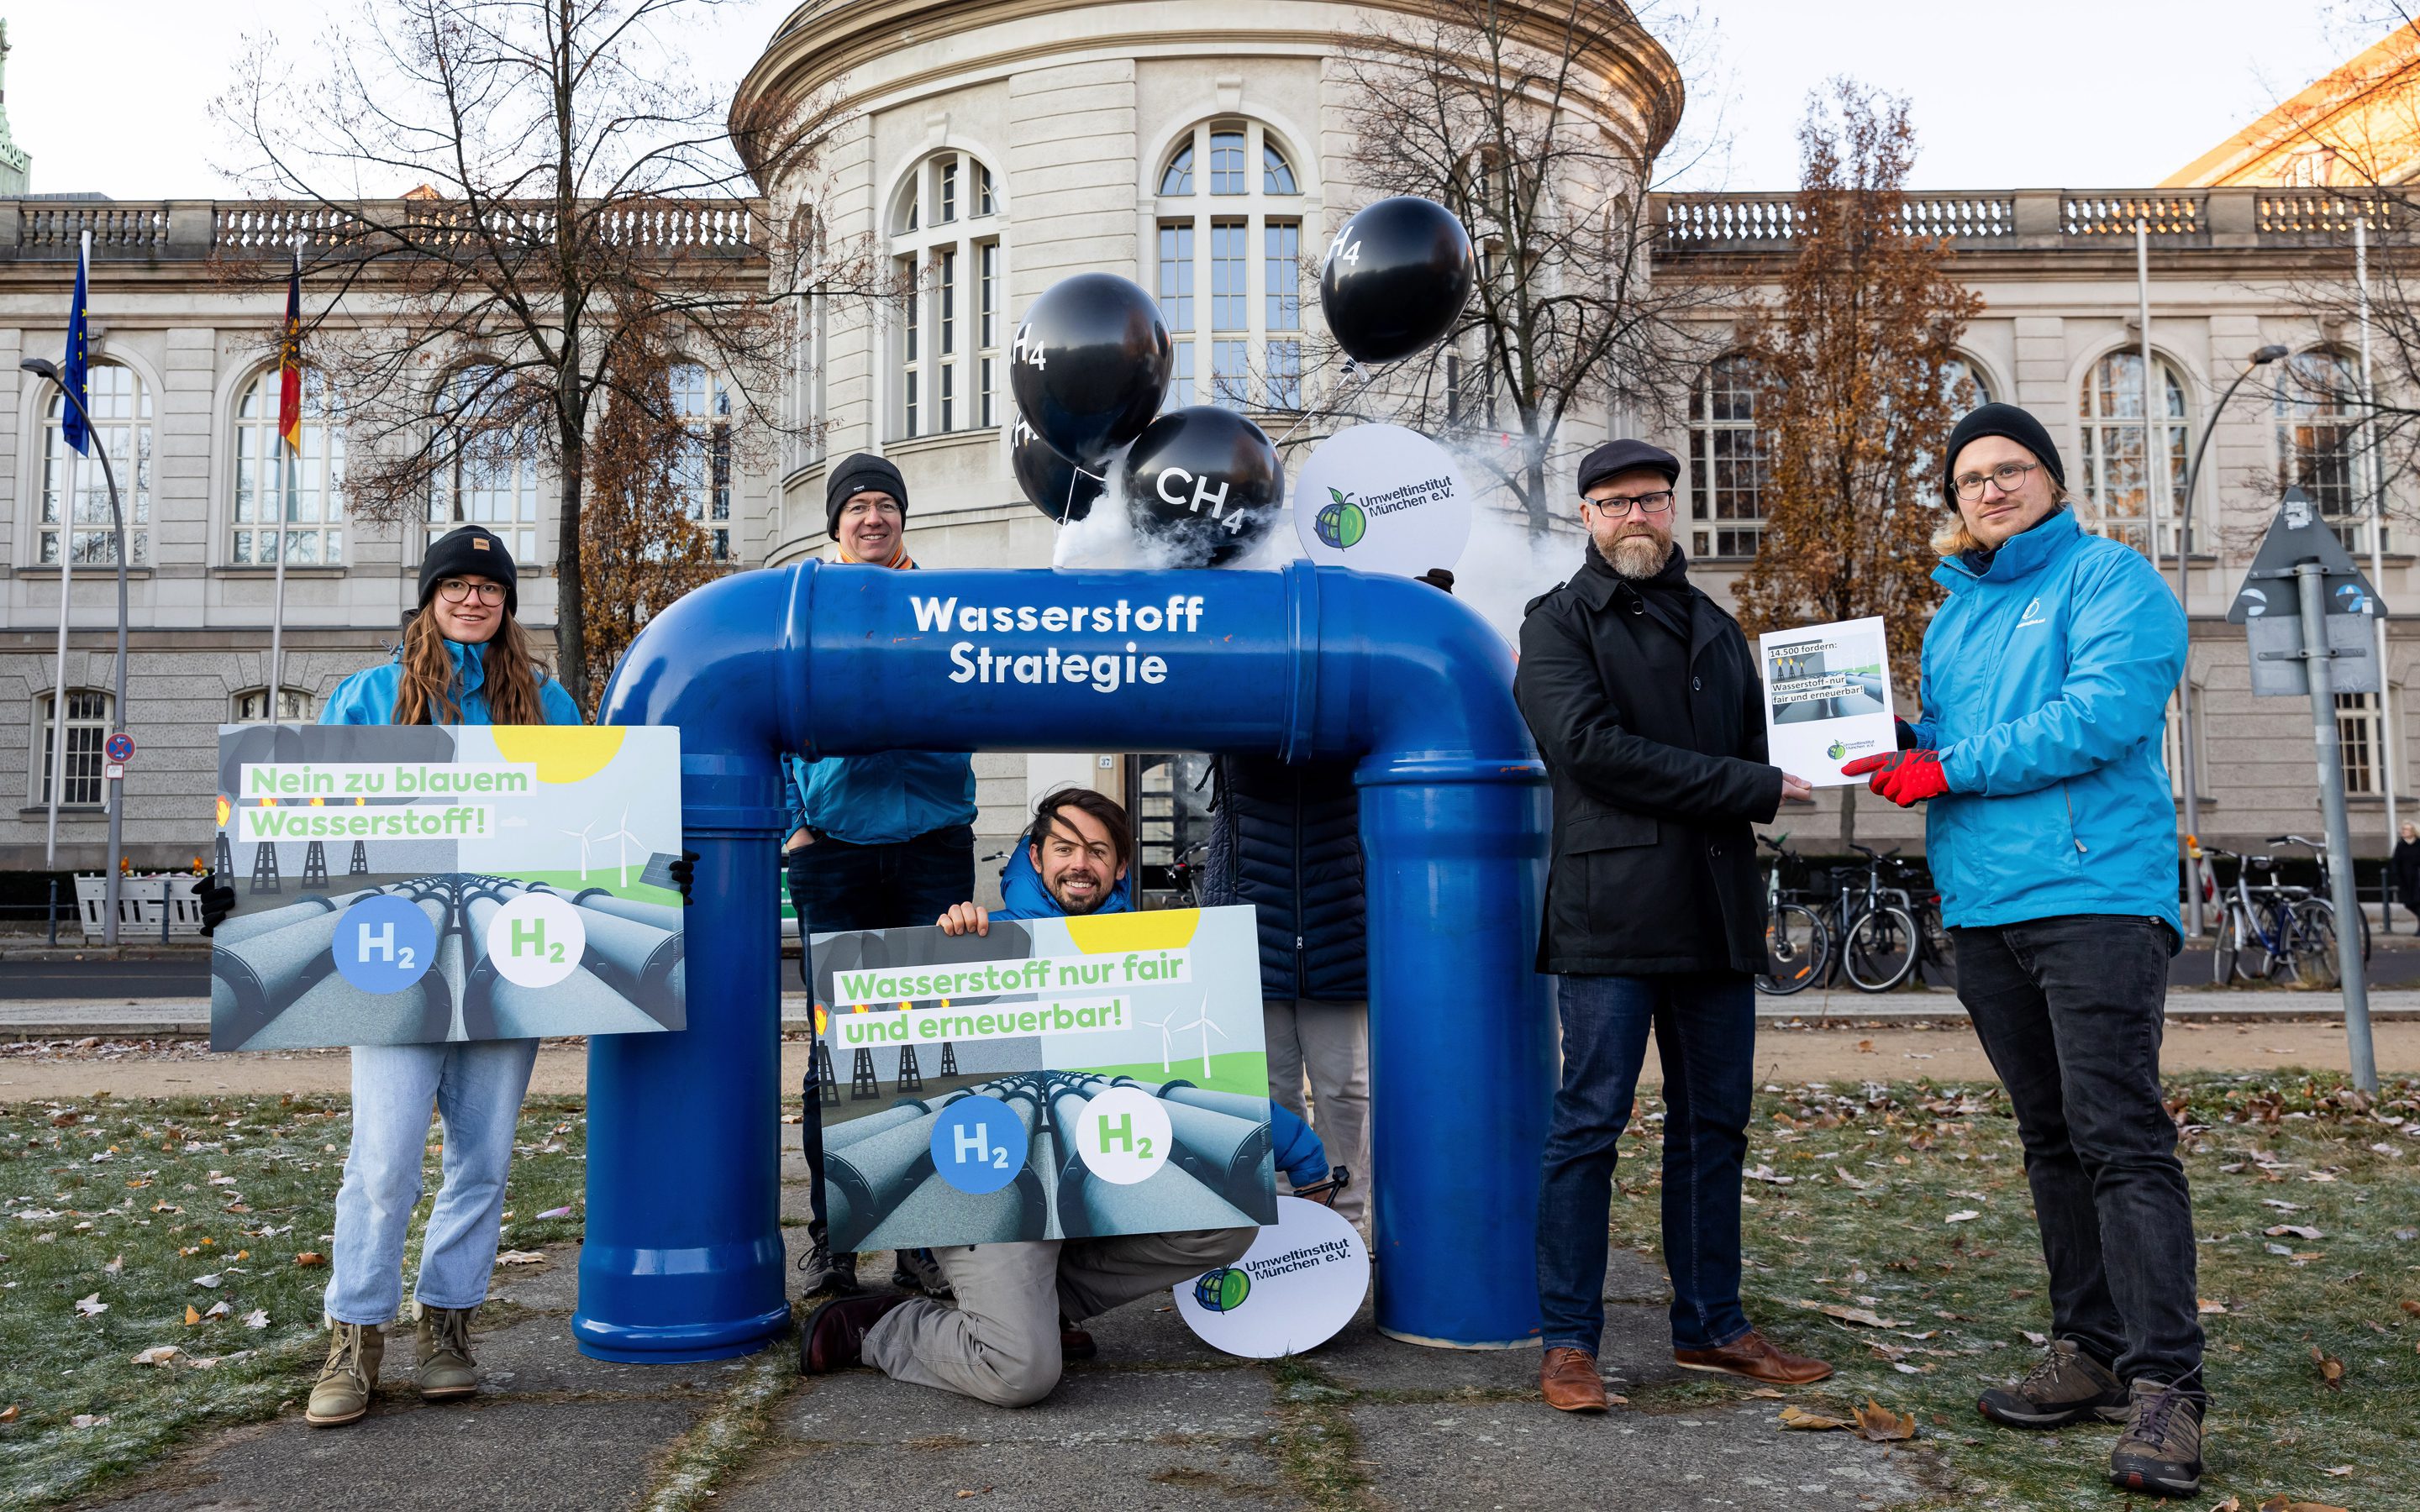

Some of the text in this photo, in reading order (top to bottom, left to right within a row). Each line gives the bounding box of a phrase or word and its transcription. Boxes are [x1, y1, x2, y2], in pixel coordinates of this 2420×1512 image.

[1009, 322, 1047, 371] H4
[1359, 475, 1453, 507] Umweltinstitut
[1368, 486, 1455, 517] München e.V.
[910, 595, 1204, 633] Wasserstoff
[948, 640, 1168, 693] Strategie
[1770, 642, 1838, 658] 14.500 fordern:
[1773, 685, 1864, 704] fair und erneuerbar!
[251, 765, 528, 794] Nein zu blauem
[249, 806, 486, 837] Wasserstoff!
[841, 952, 1184, 1000] Wasserstoff nur fair
[845, 998, 1122, 1044] und erneuerbar!
[1245, 1238, 1349, 1272] Umweltinstitut
[1255, 1248, 1351, 1281] München e.V.
